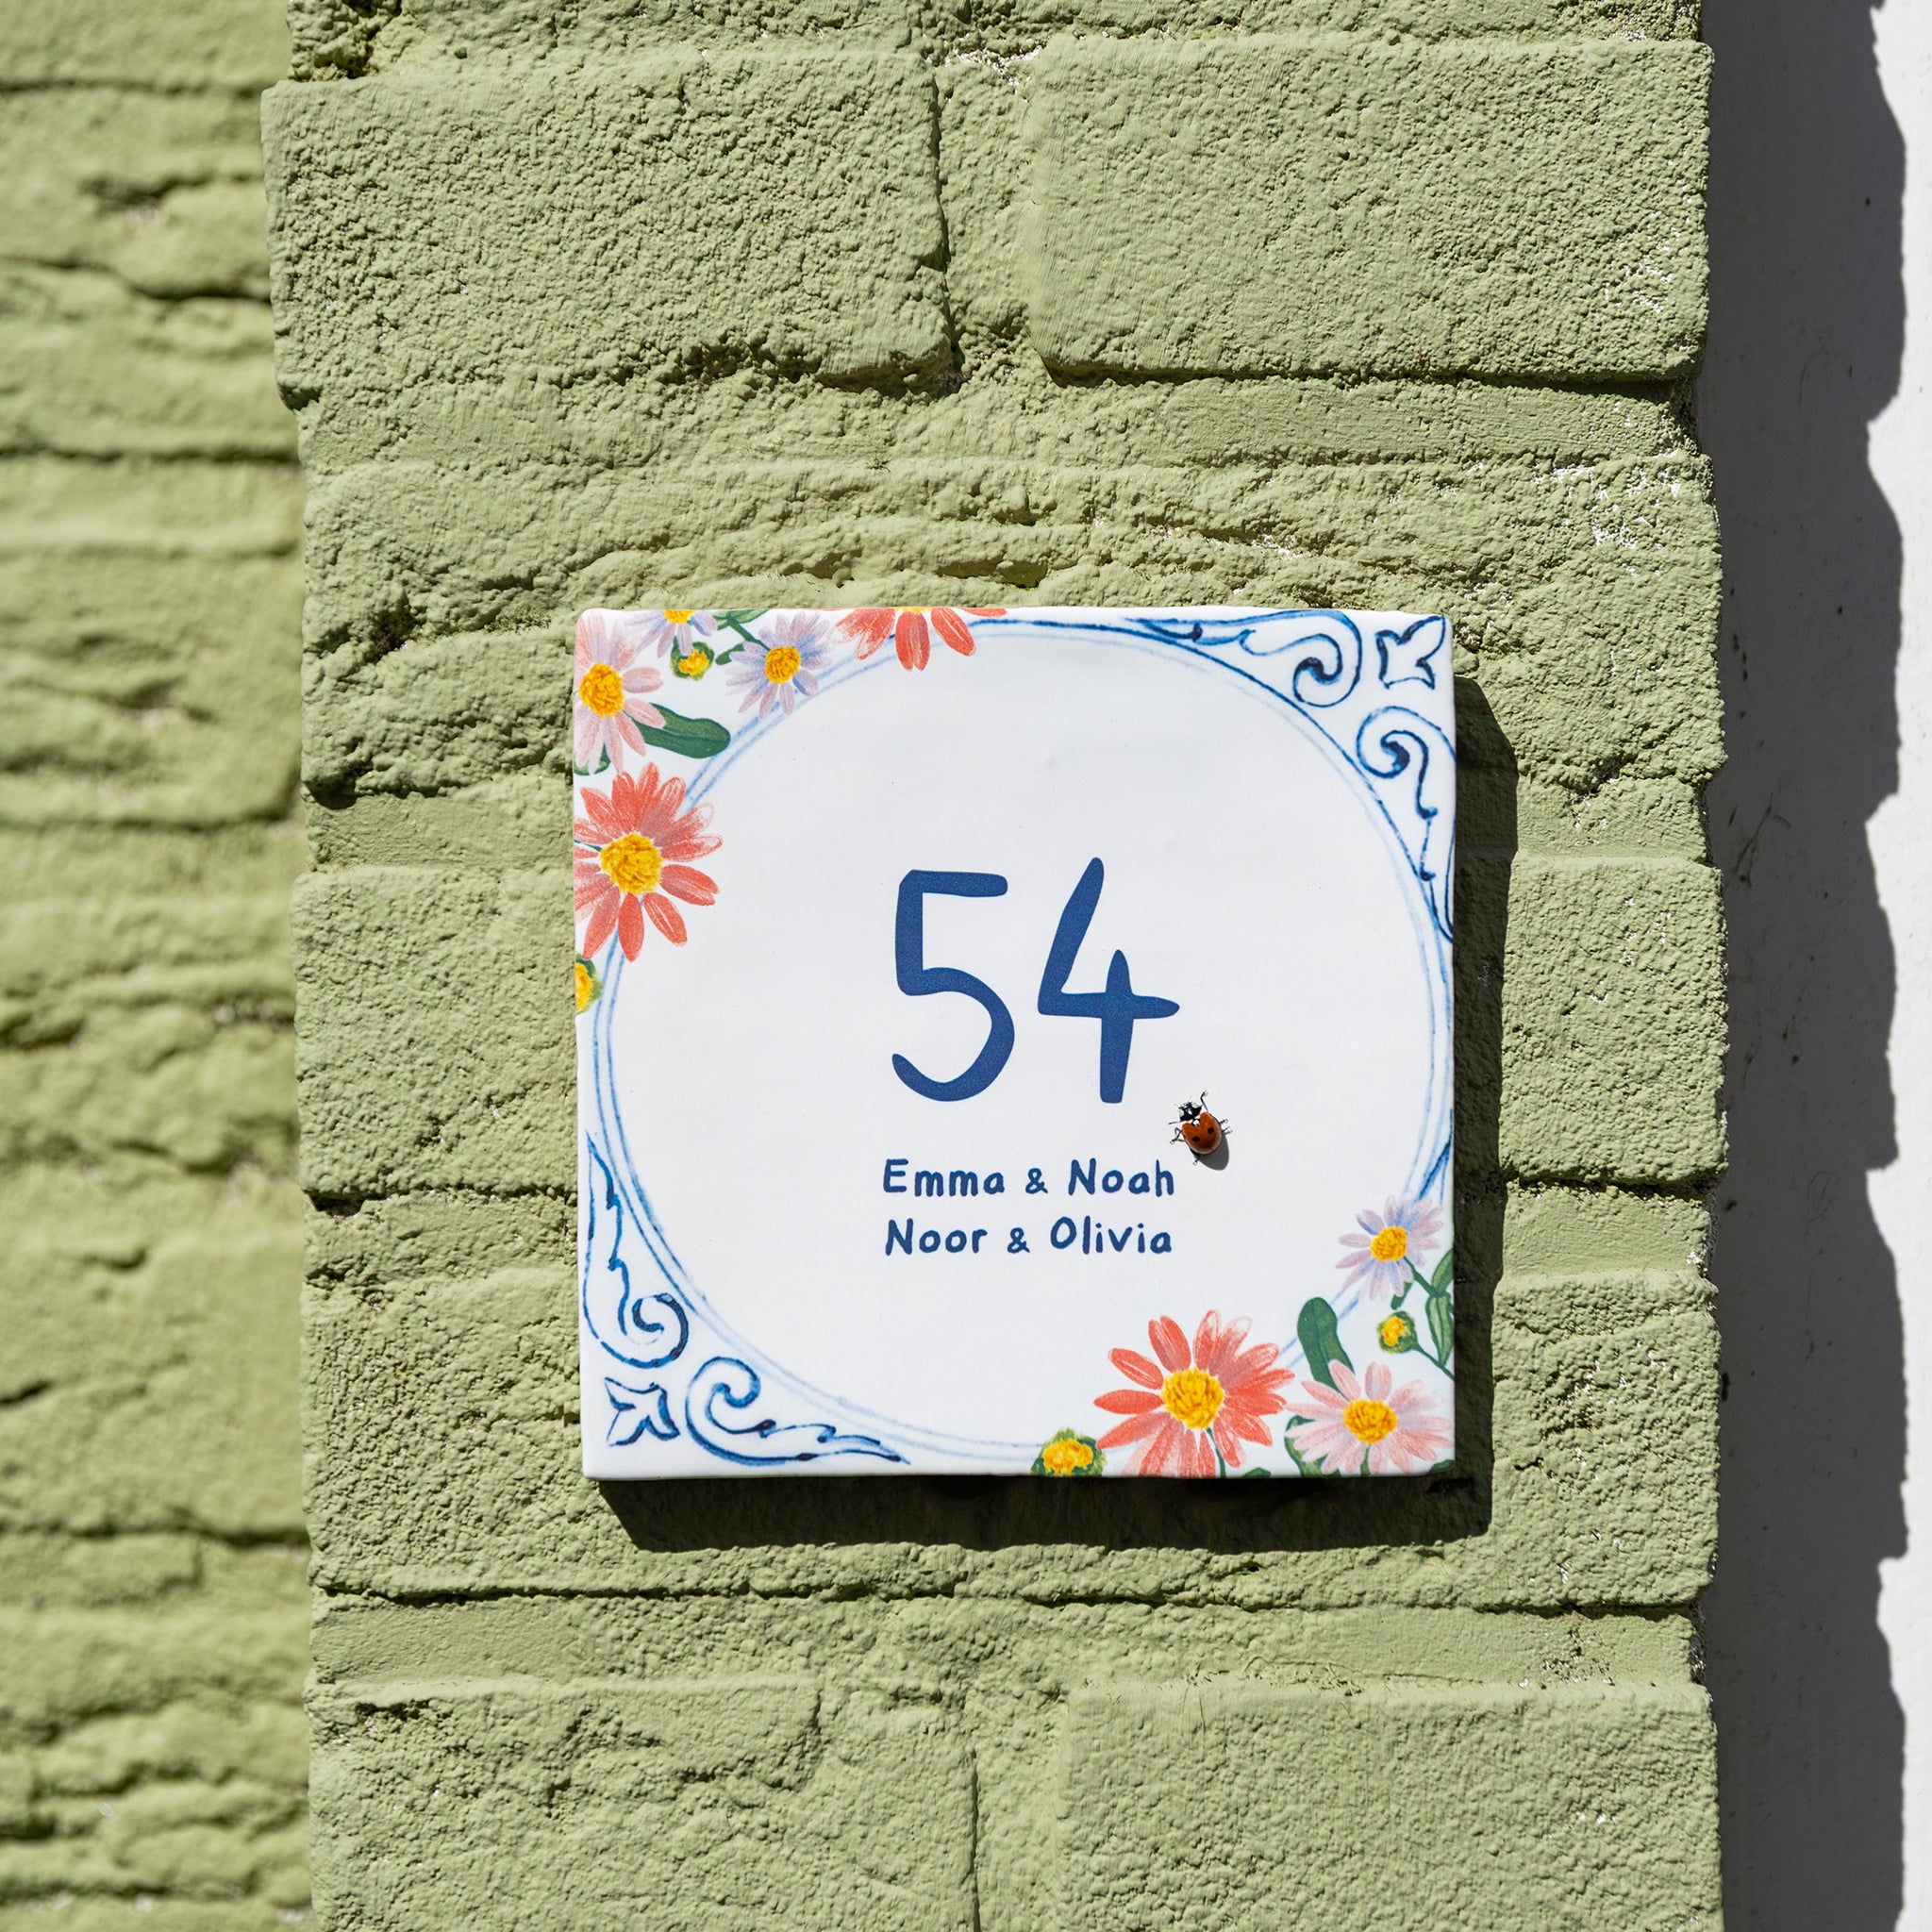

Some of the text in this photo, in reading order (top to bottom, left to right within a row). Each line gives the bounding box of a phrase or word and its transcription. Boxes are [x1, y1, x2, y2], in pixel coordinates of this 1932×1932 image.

[891, 857, 1181, 1105] 54
[882, 1157, 1174, 1198] Emma & Noah
[885, 1215, 1173, 1257] Noor & Olivia
